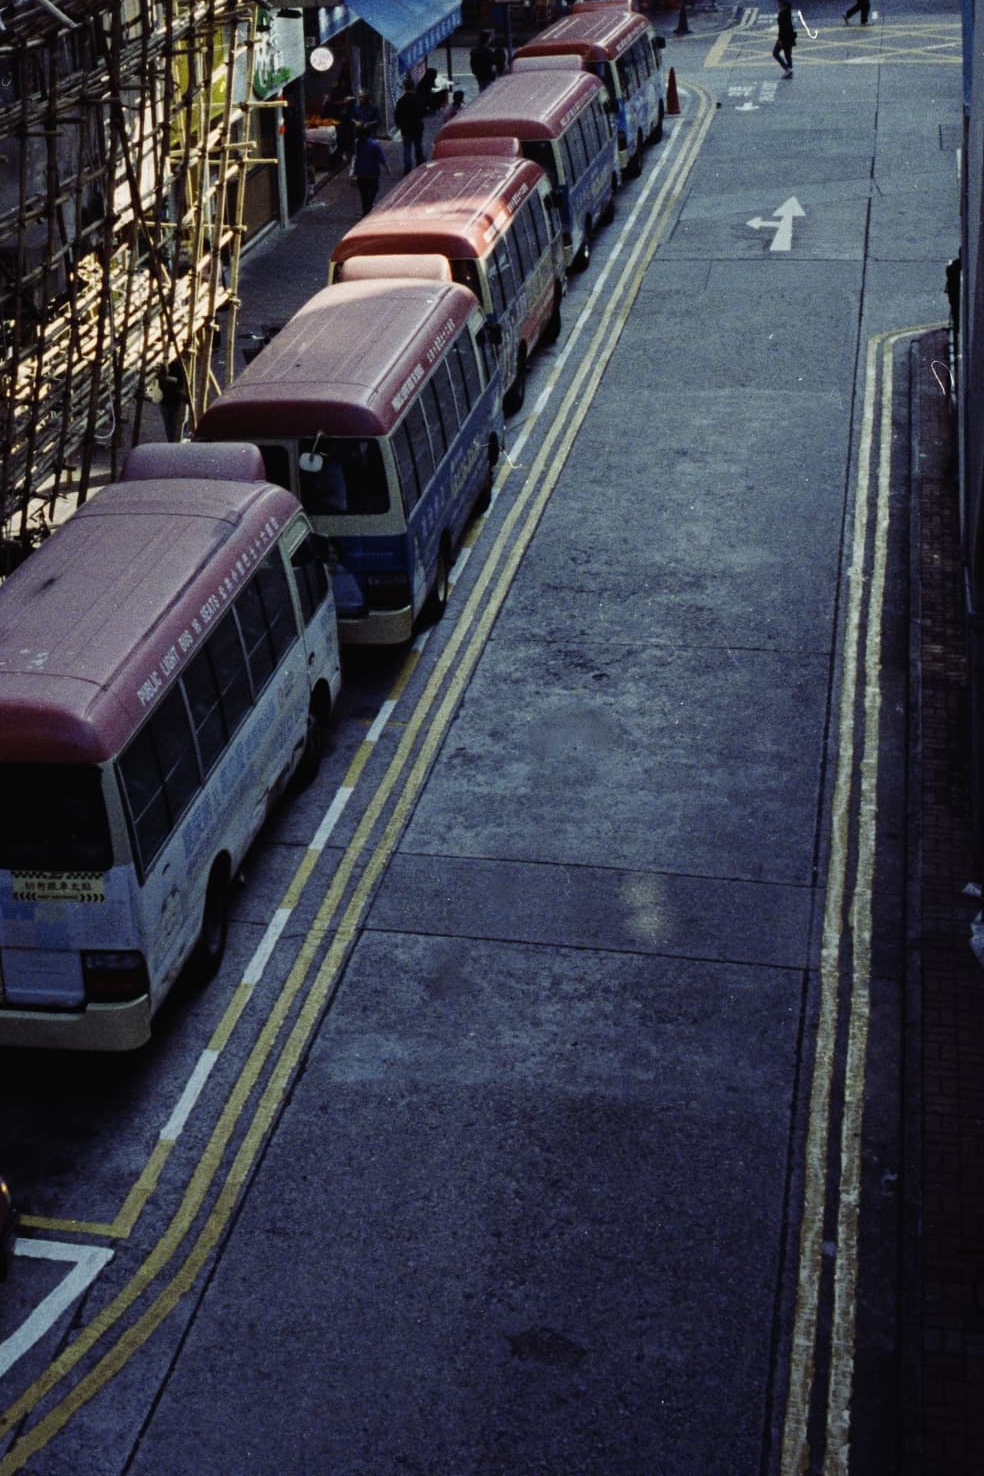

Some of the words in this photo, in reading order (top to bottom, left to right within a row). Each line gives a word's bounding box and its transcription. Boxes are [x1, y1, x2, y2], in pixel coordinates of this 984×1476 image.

[136, 670, 163, 706] PUBLIC
[159, 645, 181, 677] LIGHT
[177, 629, 195, 653] BUS
[200, 594, 221, 624] SEATS
